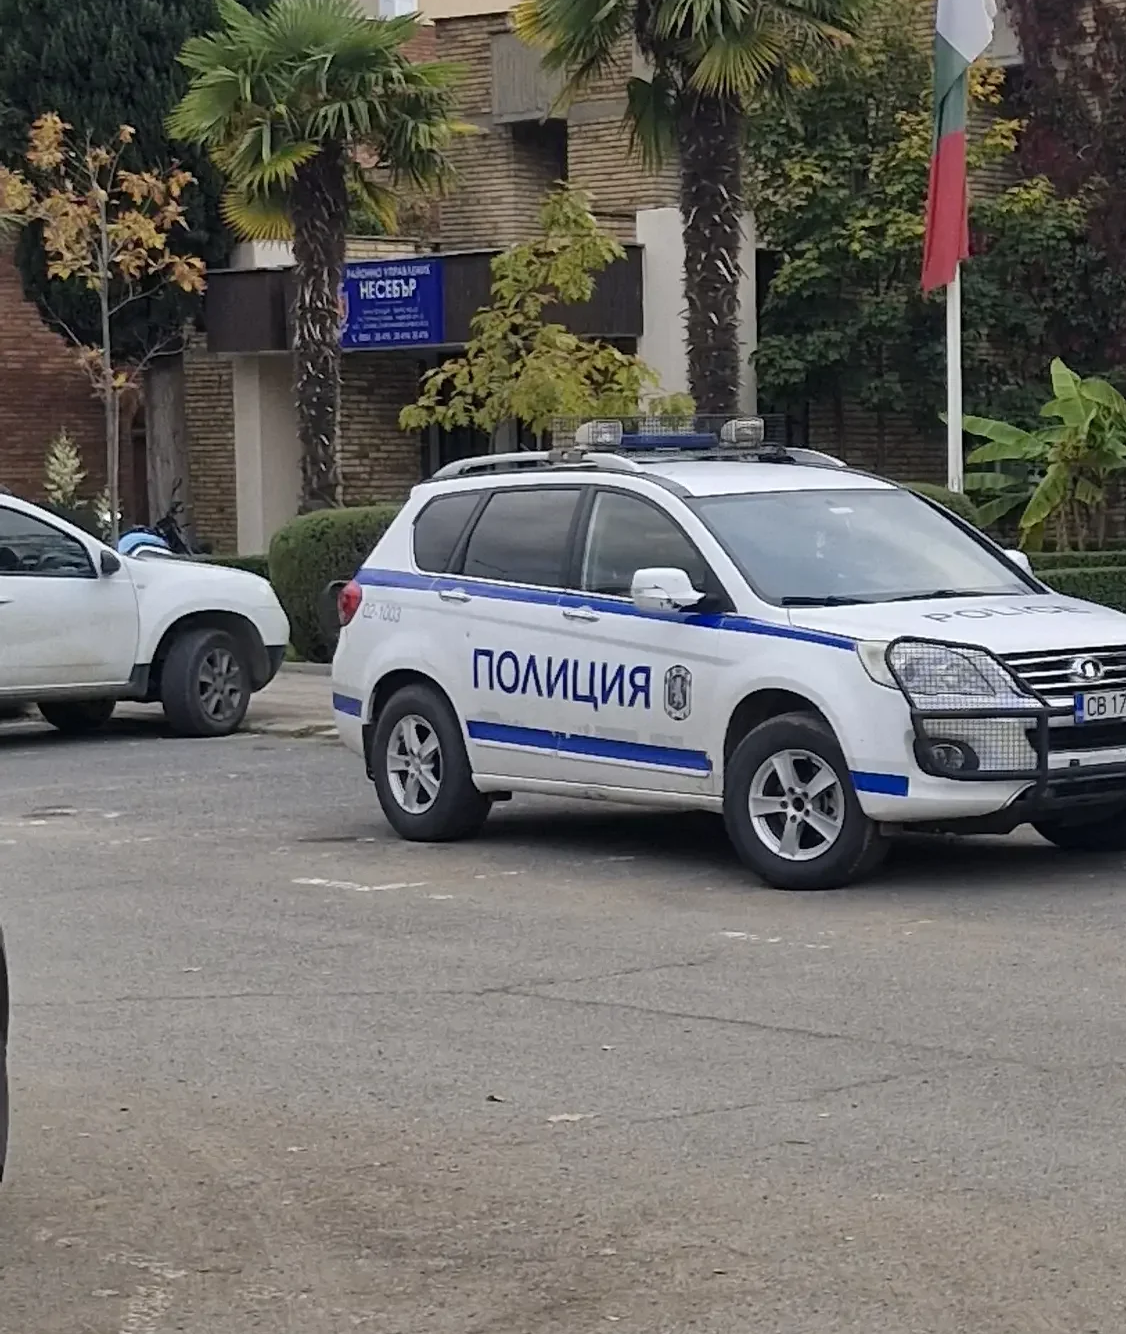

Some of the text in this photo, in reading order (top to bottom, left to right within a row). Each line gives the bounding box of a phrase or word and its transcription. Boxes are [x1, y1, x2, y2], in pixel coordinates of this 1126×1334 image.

[359, 278, 417, 299] НЕСЕБЪР
[921, 605, 1092, 623] POLICE
[473, 647, 652, 712] ПОЛИЦИЯ
